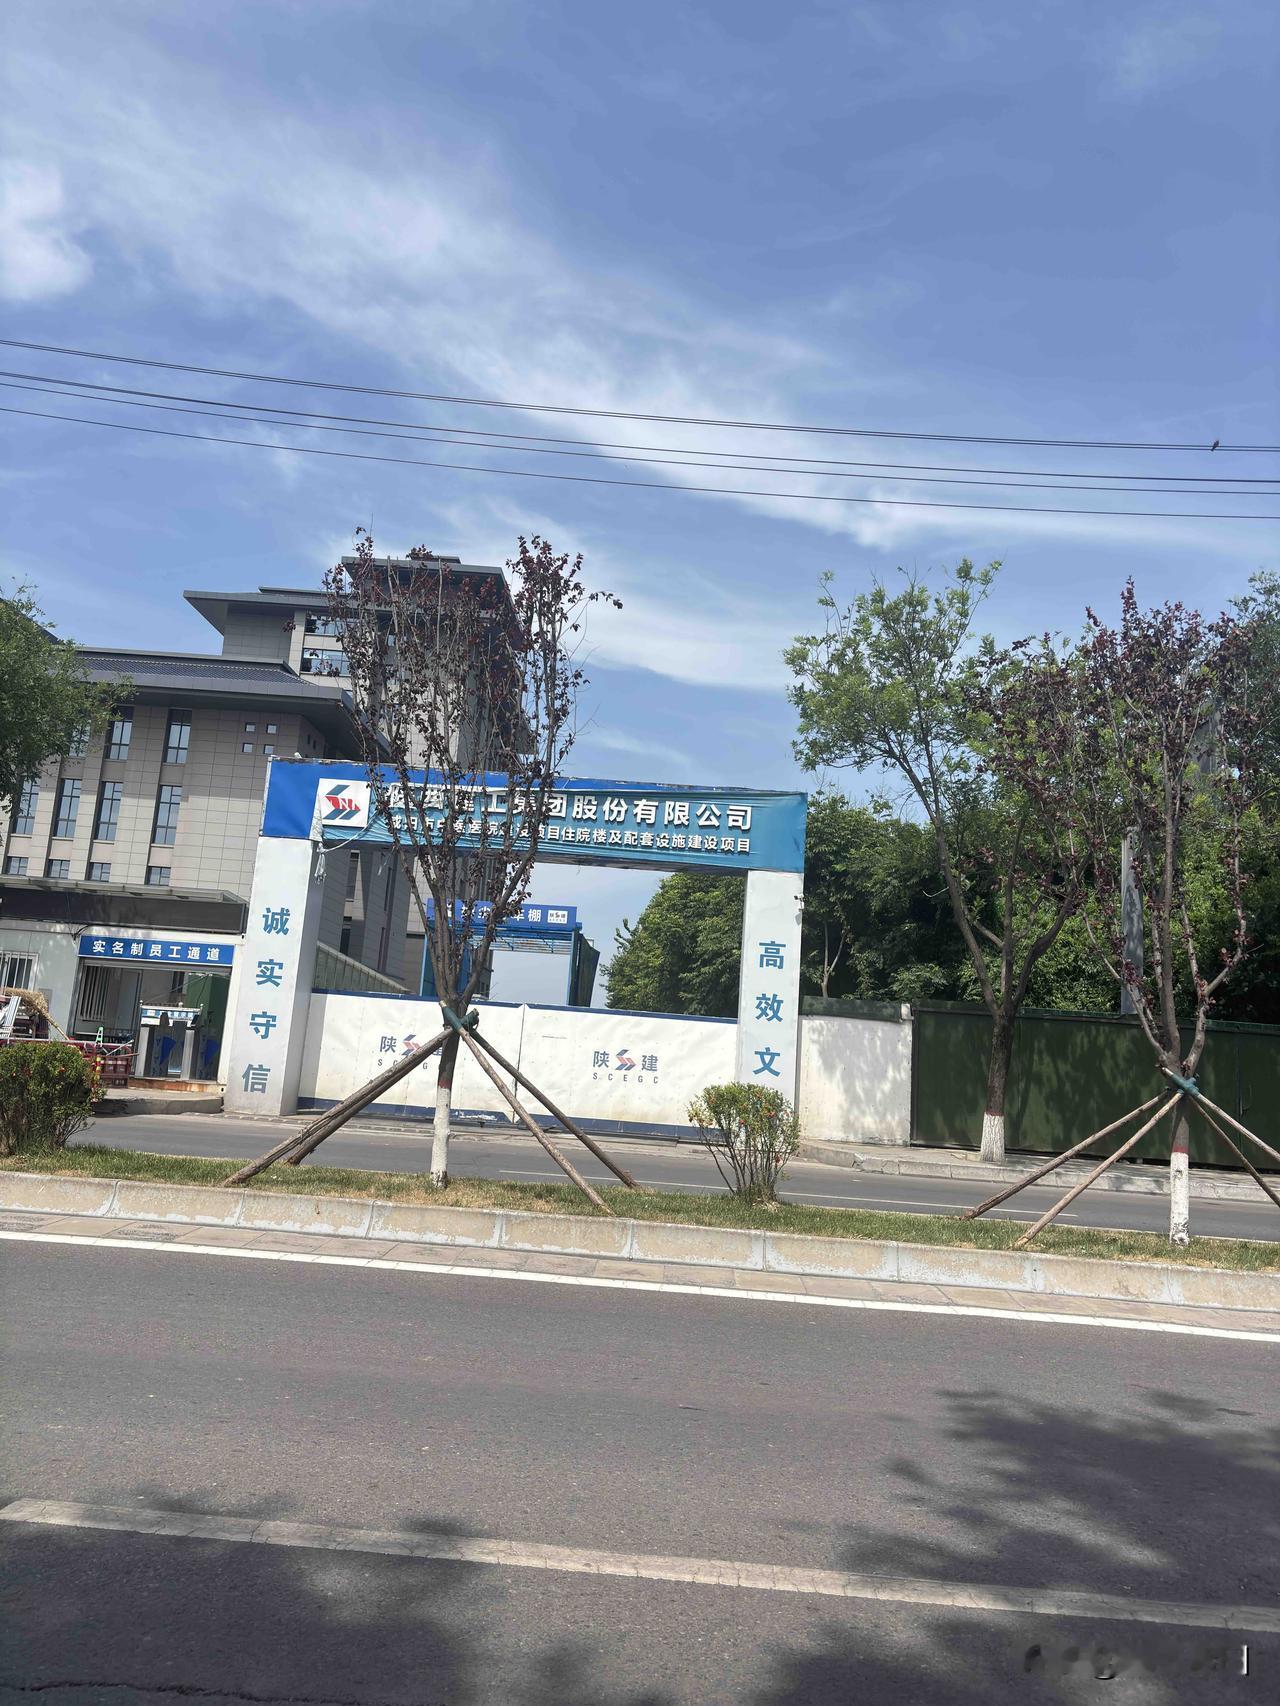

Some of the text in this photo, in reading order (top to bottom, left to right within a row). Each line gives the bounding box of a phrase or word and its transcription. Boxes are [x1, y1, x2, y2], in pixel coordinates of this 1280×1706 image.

[93, 940, 220, 961] 实名制员工通道
[242, 907, 290, 1093] 诚实守信
[593, 1072, 658, 1084] SCEGC
